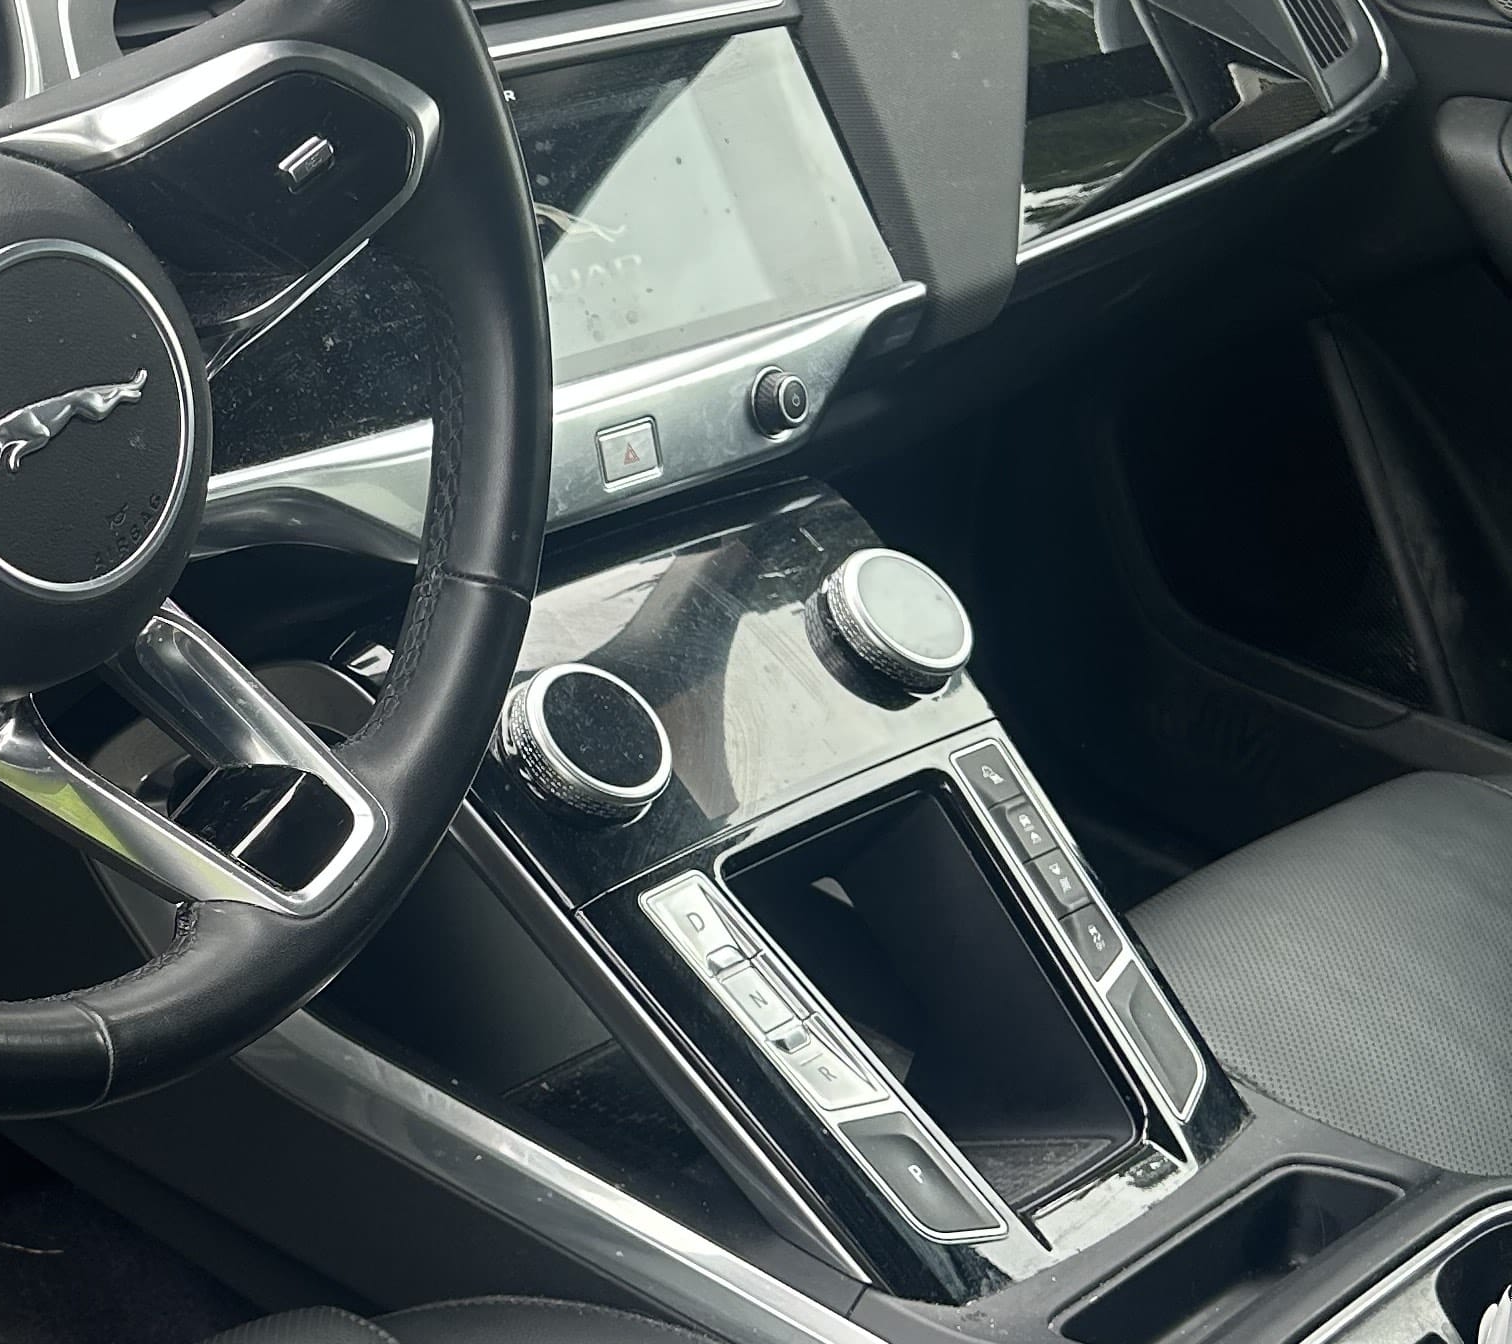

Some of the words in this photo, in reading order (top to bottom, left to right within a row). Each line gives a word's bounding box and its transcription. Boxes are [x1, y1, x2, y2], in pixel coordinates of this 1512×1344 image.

[686, 912, 706, 933] D
[748, 990, 769, 1009] N
[817, 1065, 838, 1083] R
[908, 1164, 925, 1184] P
